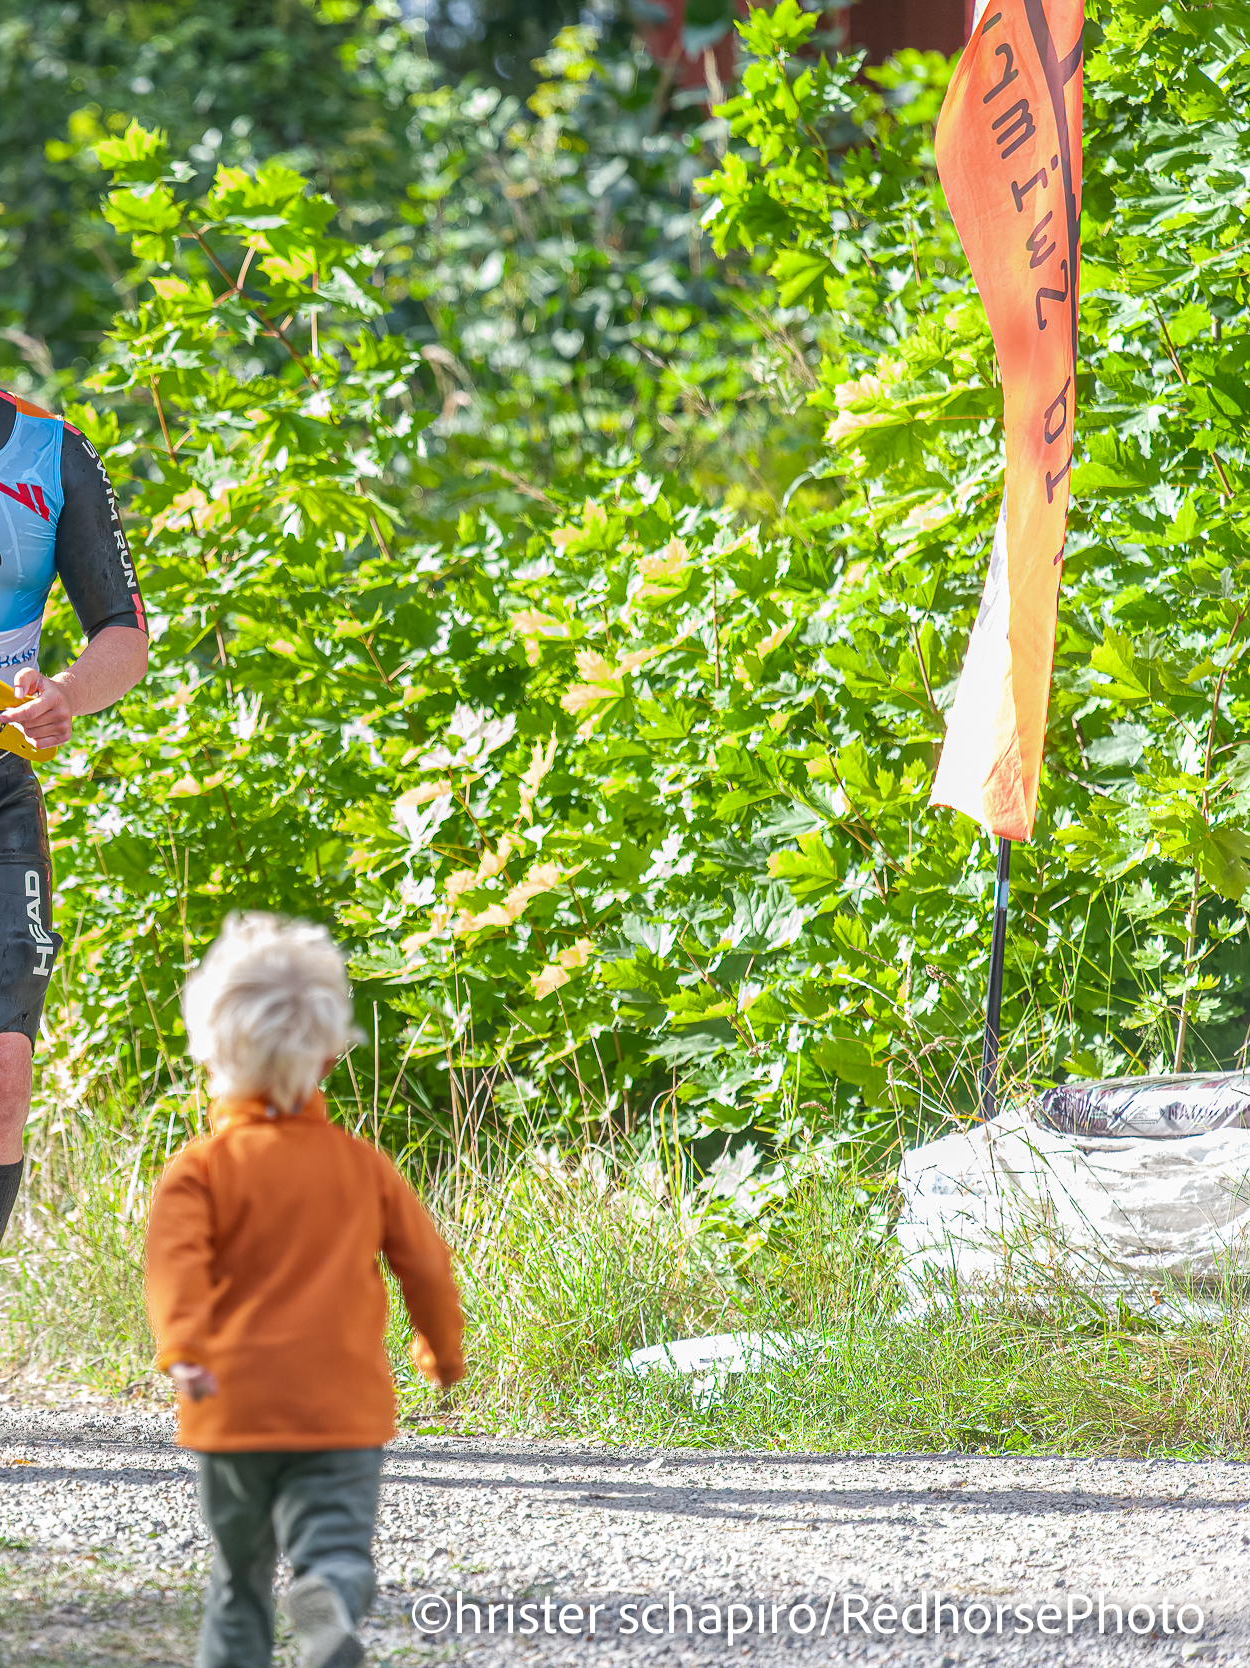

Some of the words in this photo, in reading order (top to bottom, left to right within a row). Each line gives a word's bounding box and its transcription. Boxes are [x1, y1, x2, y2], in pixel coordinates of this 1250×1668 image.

[82, 440, 119, 522] SWIM
[113, 530, 137, 589] RUN
[25, 870, 53, 977] HEAD
